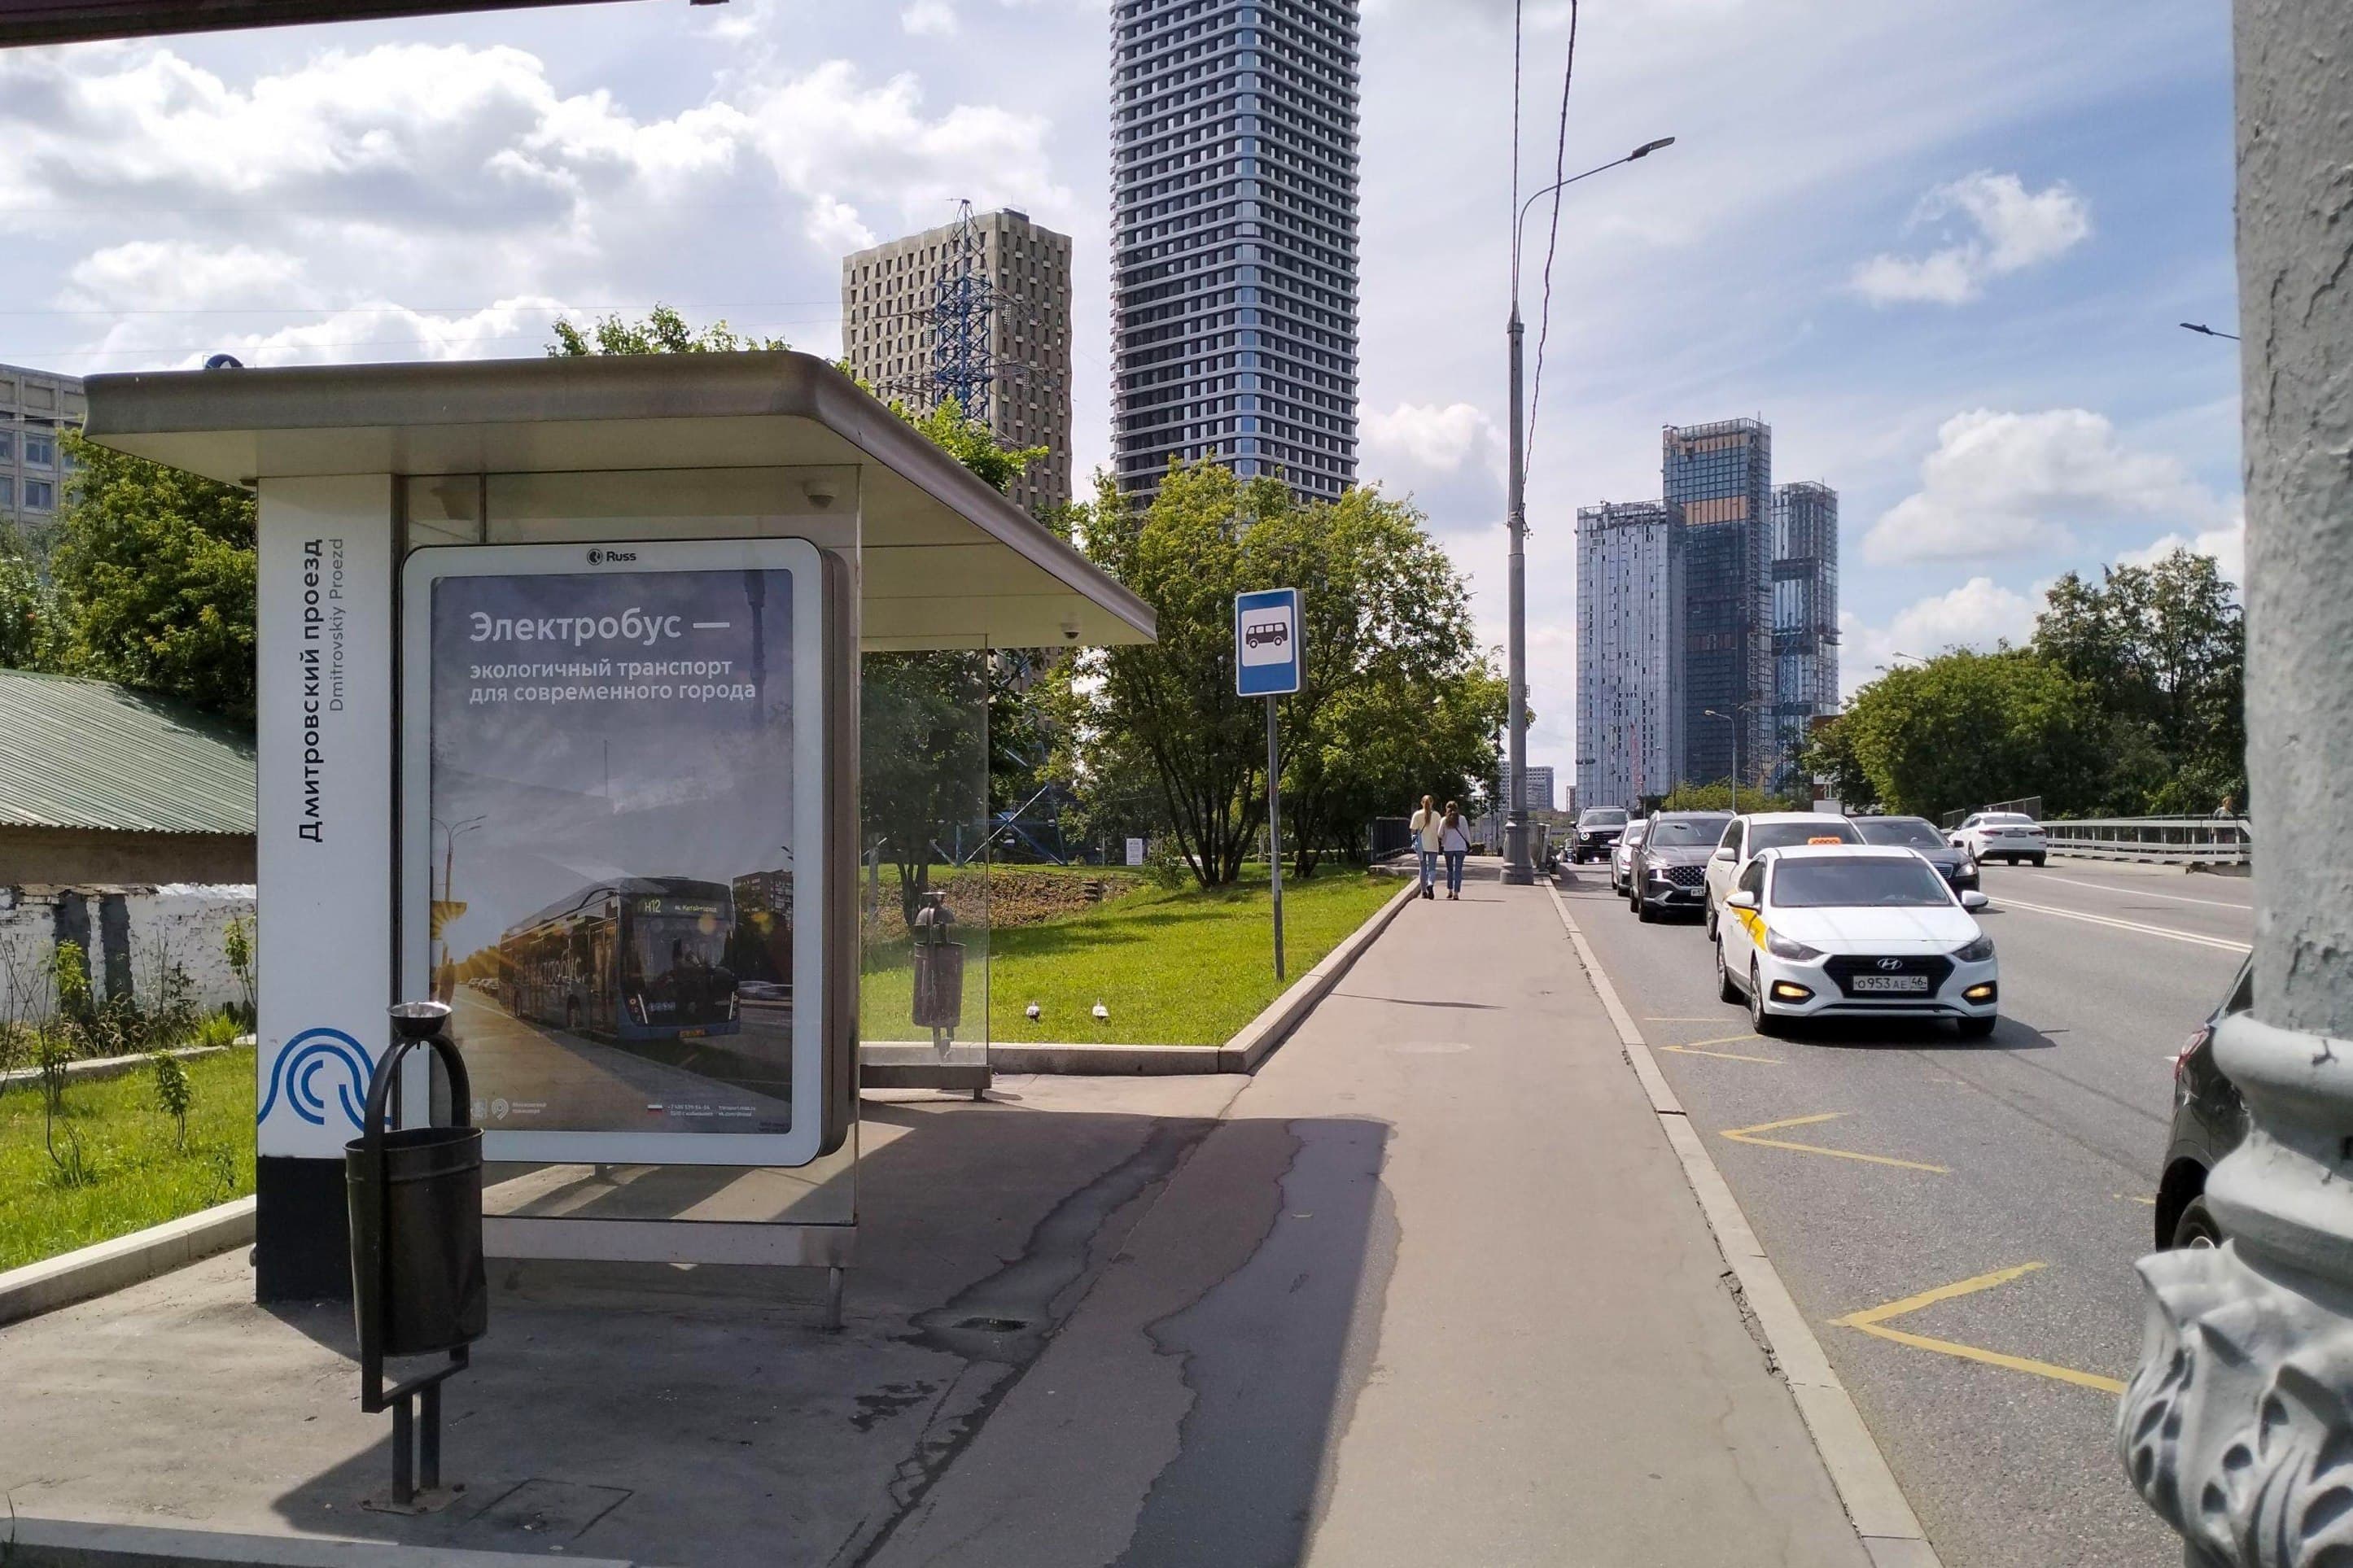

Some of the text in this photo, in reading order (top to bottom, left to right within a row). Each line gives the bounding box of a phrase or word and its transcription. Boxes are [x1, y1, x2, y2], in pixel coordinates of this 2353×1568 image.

[606, 551, 637, 562] Russ
[329, 538, 346, 712] Dmitrovskiy Proezd
[469, 606, 683, 647] Электробус
[469, 658, 733, 681] экологичный транспорт
[299, 539, 325, 844] Дмитровский проезд
[469, 682, 757, 705] для современного города
